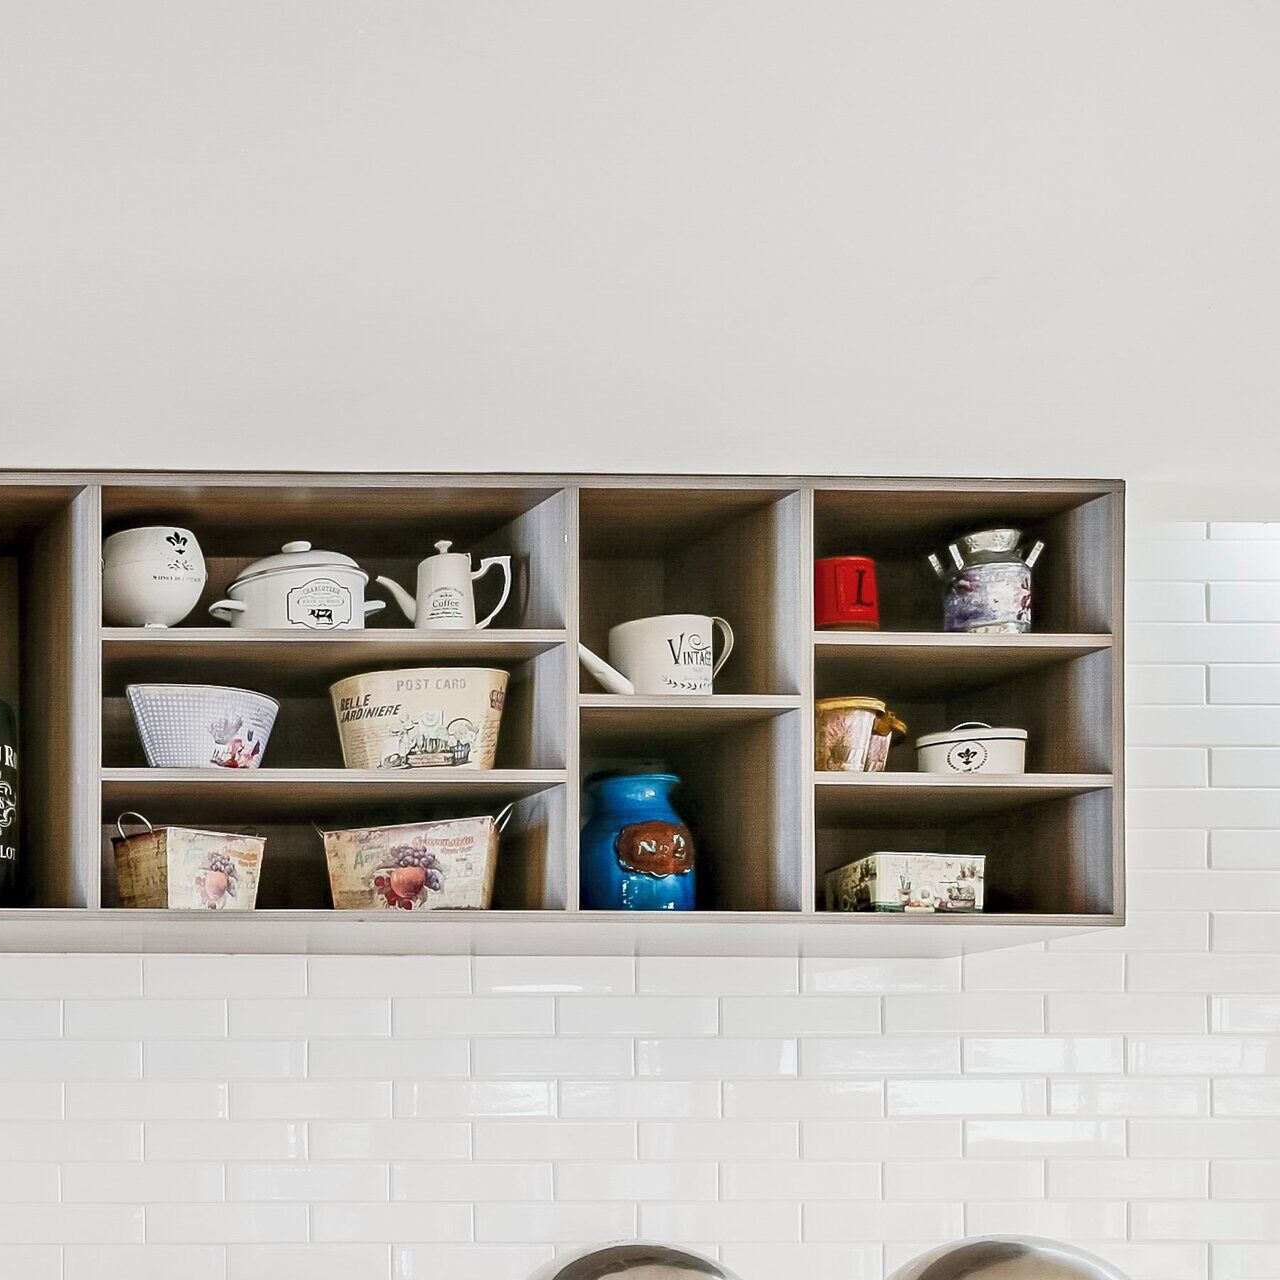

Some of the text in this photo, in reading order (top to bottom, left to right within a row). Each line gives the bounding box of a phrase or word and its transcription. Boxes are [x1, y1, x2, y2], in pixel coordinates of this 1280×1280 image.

[853, 569, 874, 607] L
[432, 599, 460, 608] Coffee
[396, 678, 466, 692] POST CARD
[340, 694, 371, 712] BELLE
